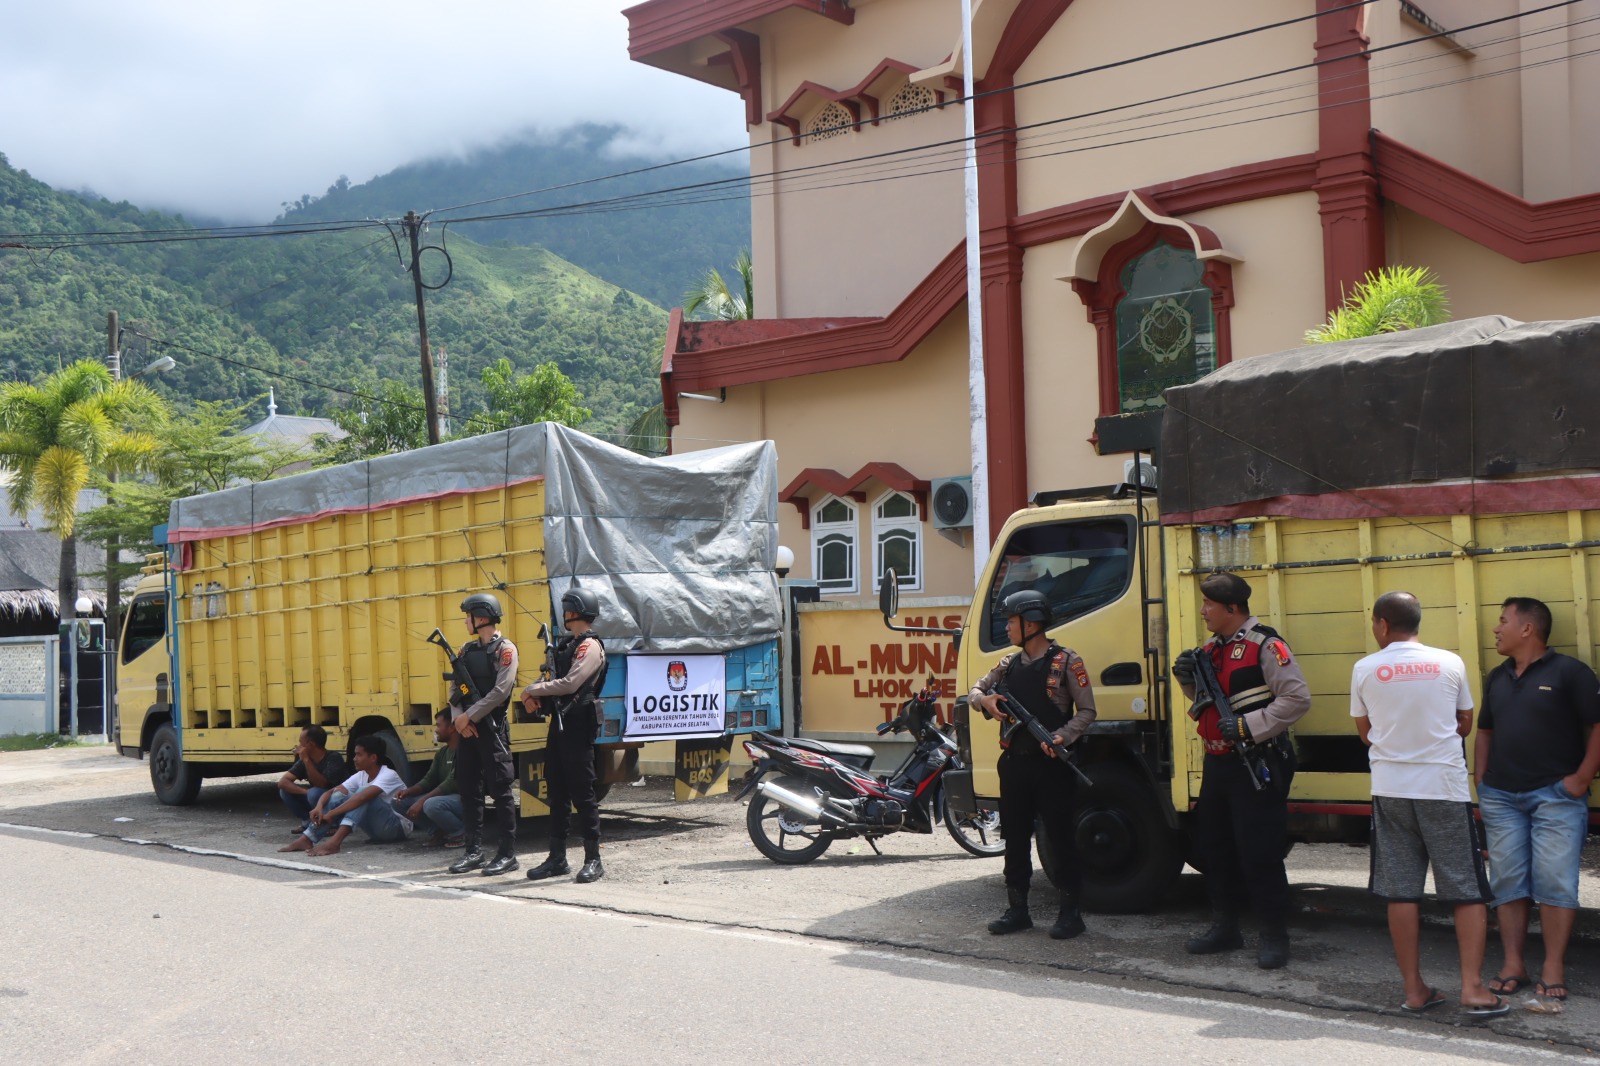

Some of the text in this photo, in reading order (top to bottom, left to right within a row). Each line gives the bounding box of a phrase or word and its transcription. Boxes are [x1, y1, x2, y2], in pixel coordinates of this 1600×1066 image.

[1376, 663, 1441, 682] ORANGE
[854, 679, 913, 698] LHOK
[633, 694, 719, 714] LOGISTIK
[689, 767, 713, 784] BOS
